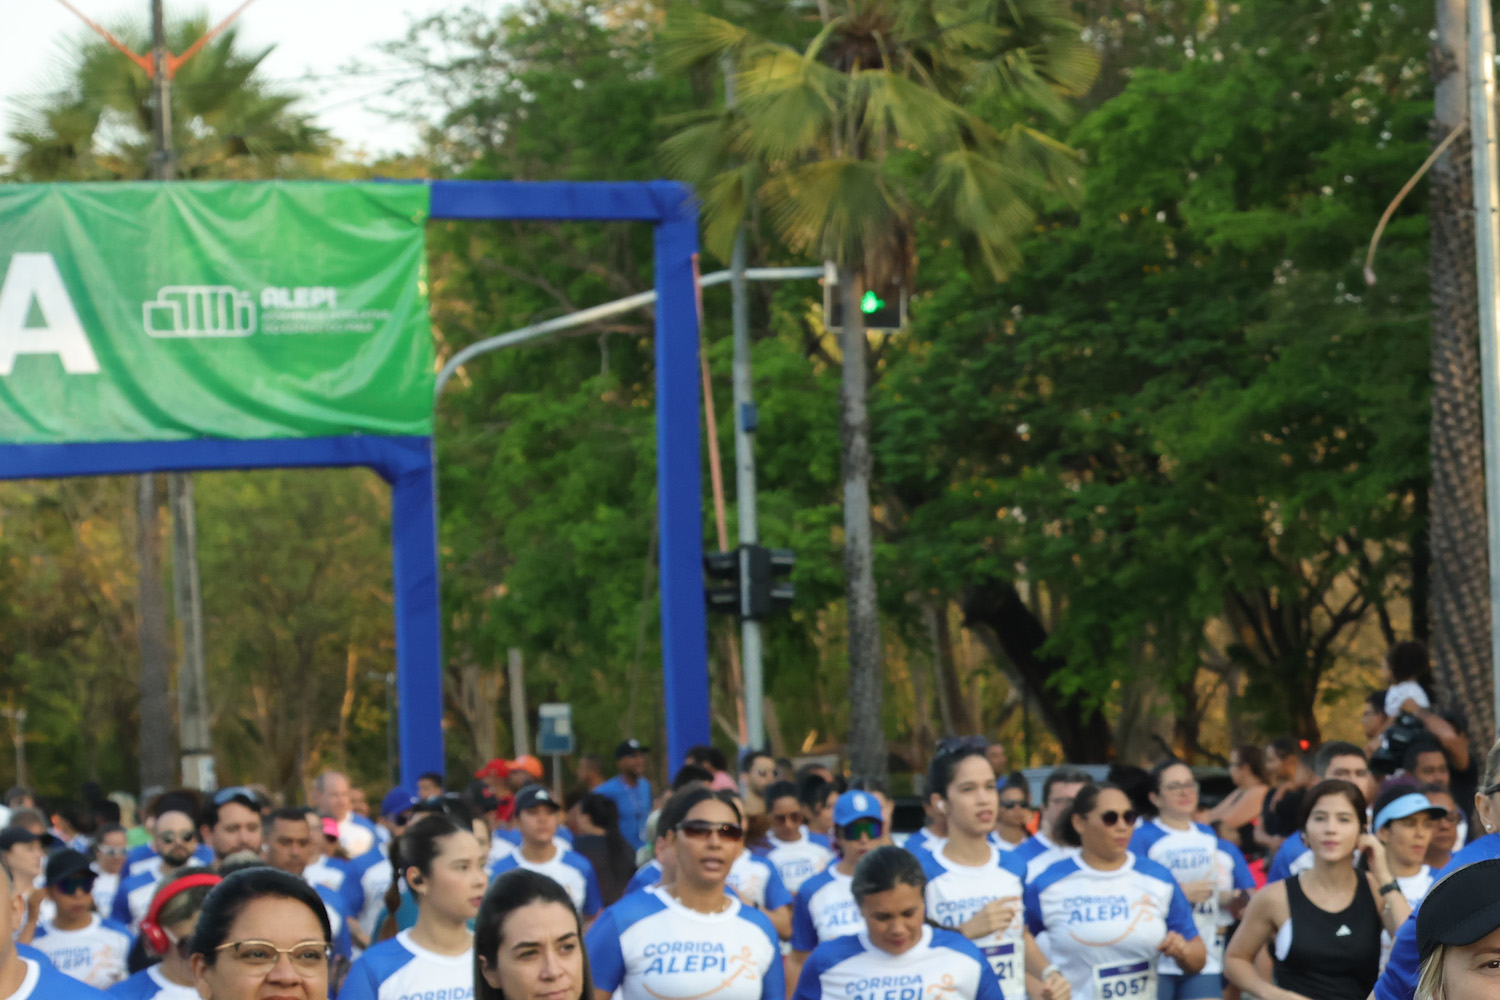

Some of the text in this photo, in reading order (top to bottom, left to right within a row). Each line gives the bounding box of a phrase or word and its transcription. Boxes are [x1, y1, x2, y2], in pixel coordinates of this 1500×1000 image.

[260, 286, 338, 309] ALEPI
[1068, 906, 1130, 925] ALEPI
[644, 941, 725, 957] CORRIDA
[644, 955, 727, 975] ALEPI
[845, 974, 923, 995] CORRIDA
[1102, 976, 1148, 999] 5057
